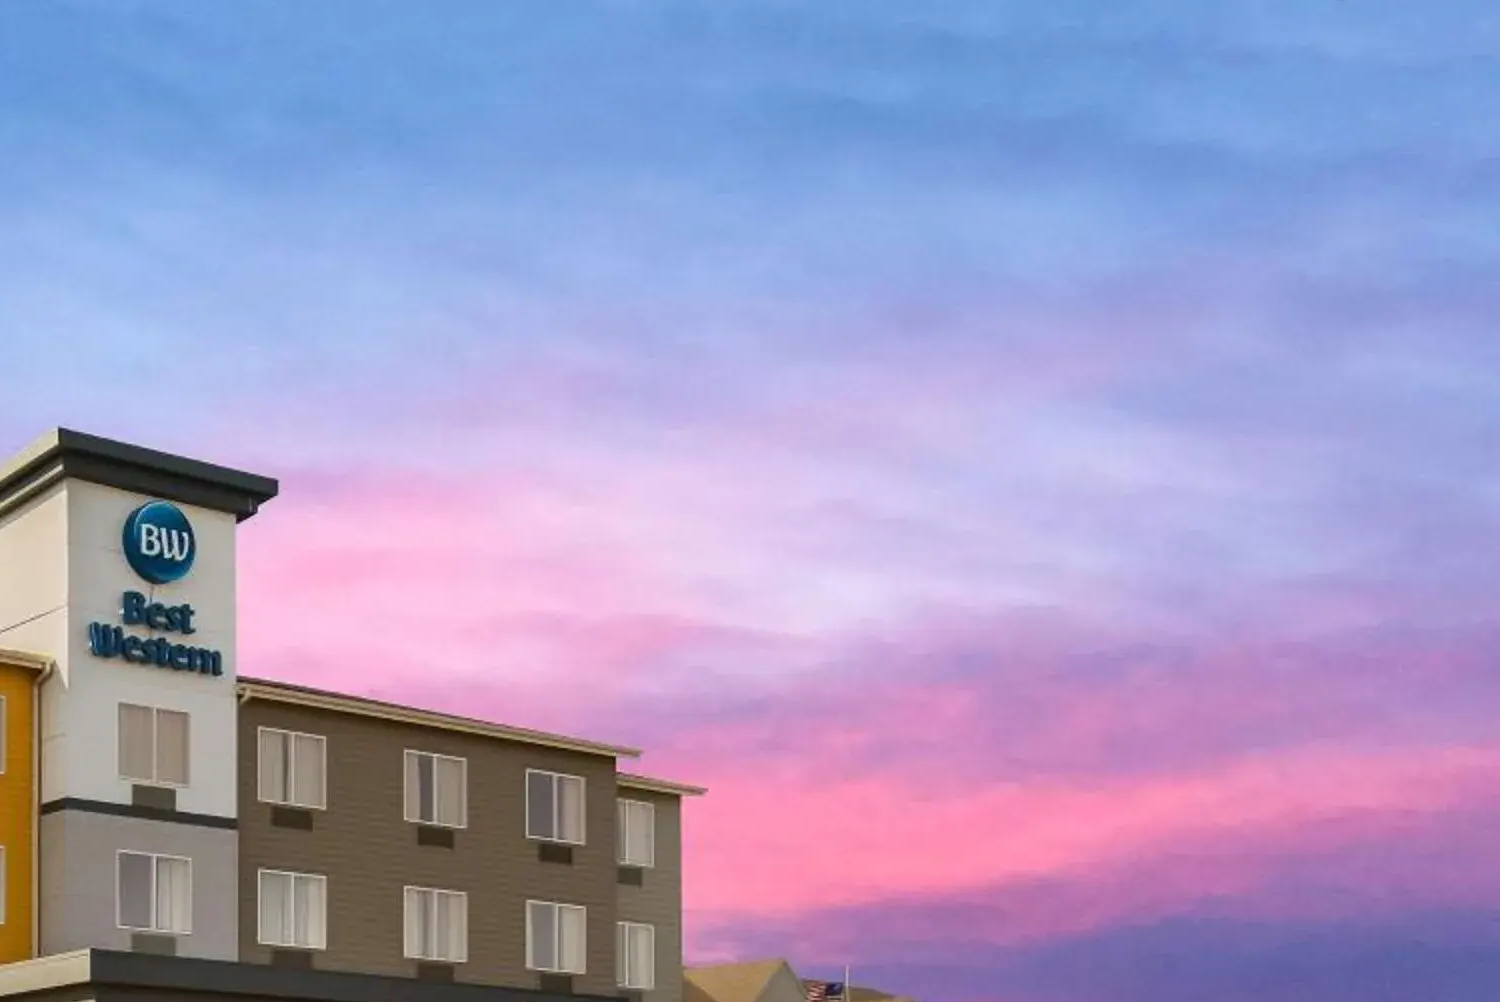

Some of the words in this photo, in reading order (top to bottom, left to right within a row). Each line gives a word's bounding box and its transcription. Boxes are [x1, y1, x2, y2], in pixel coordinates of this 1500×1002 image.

[140, 524, 189, 561] BW
[122, 591, 195, 634] Best
[88, 622, 223, 676] Western
